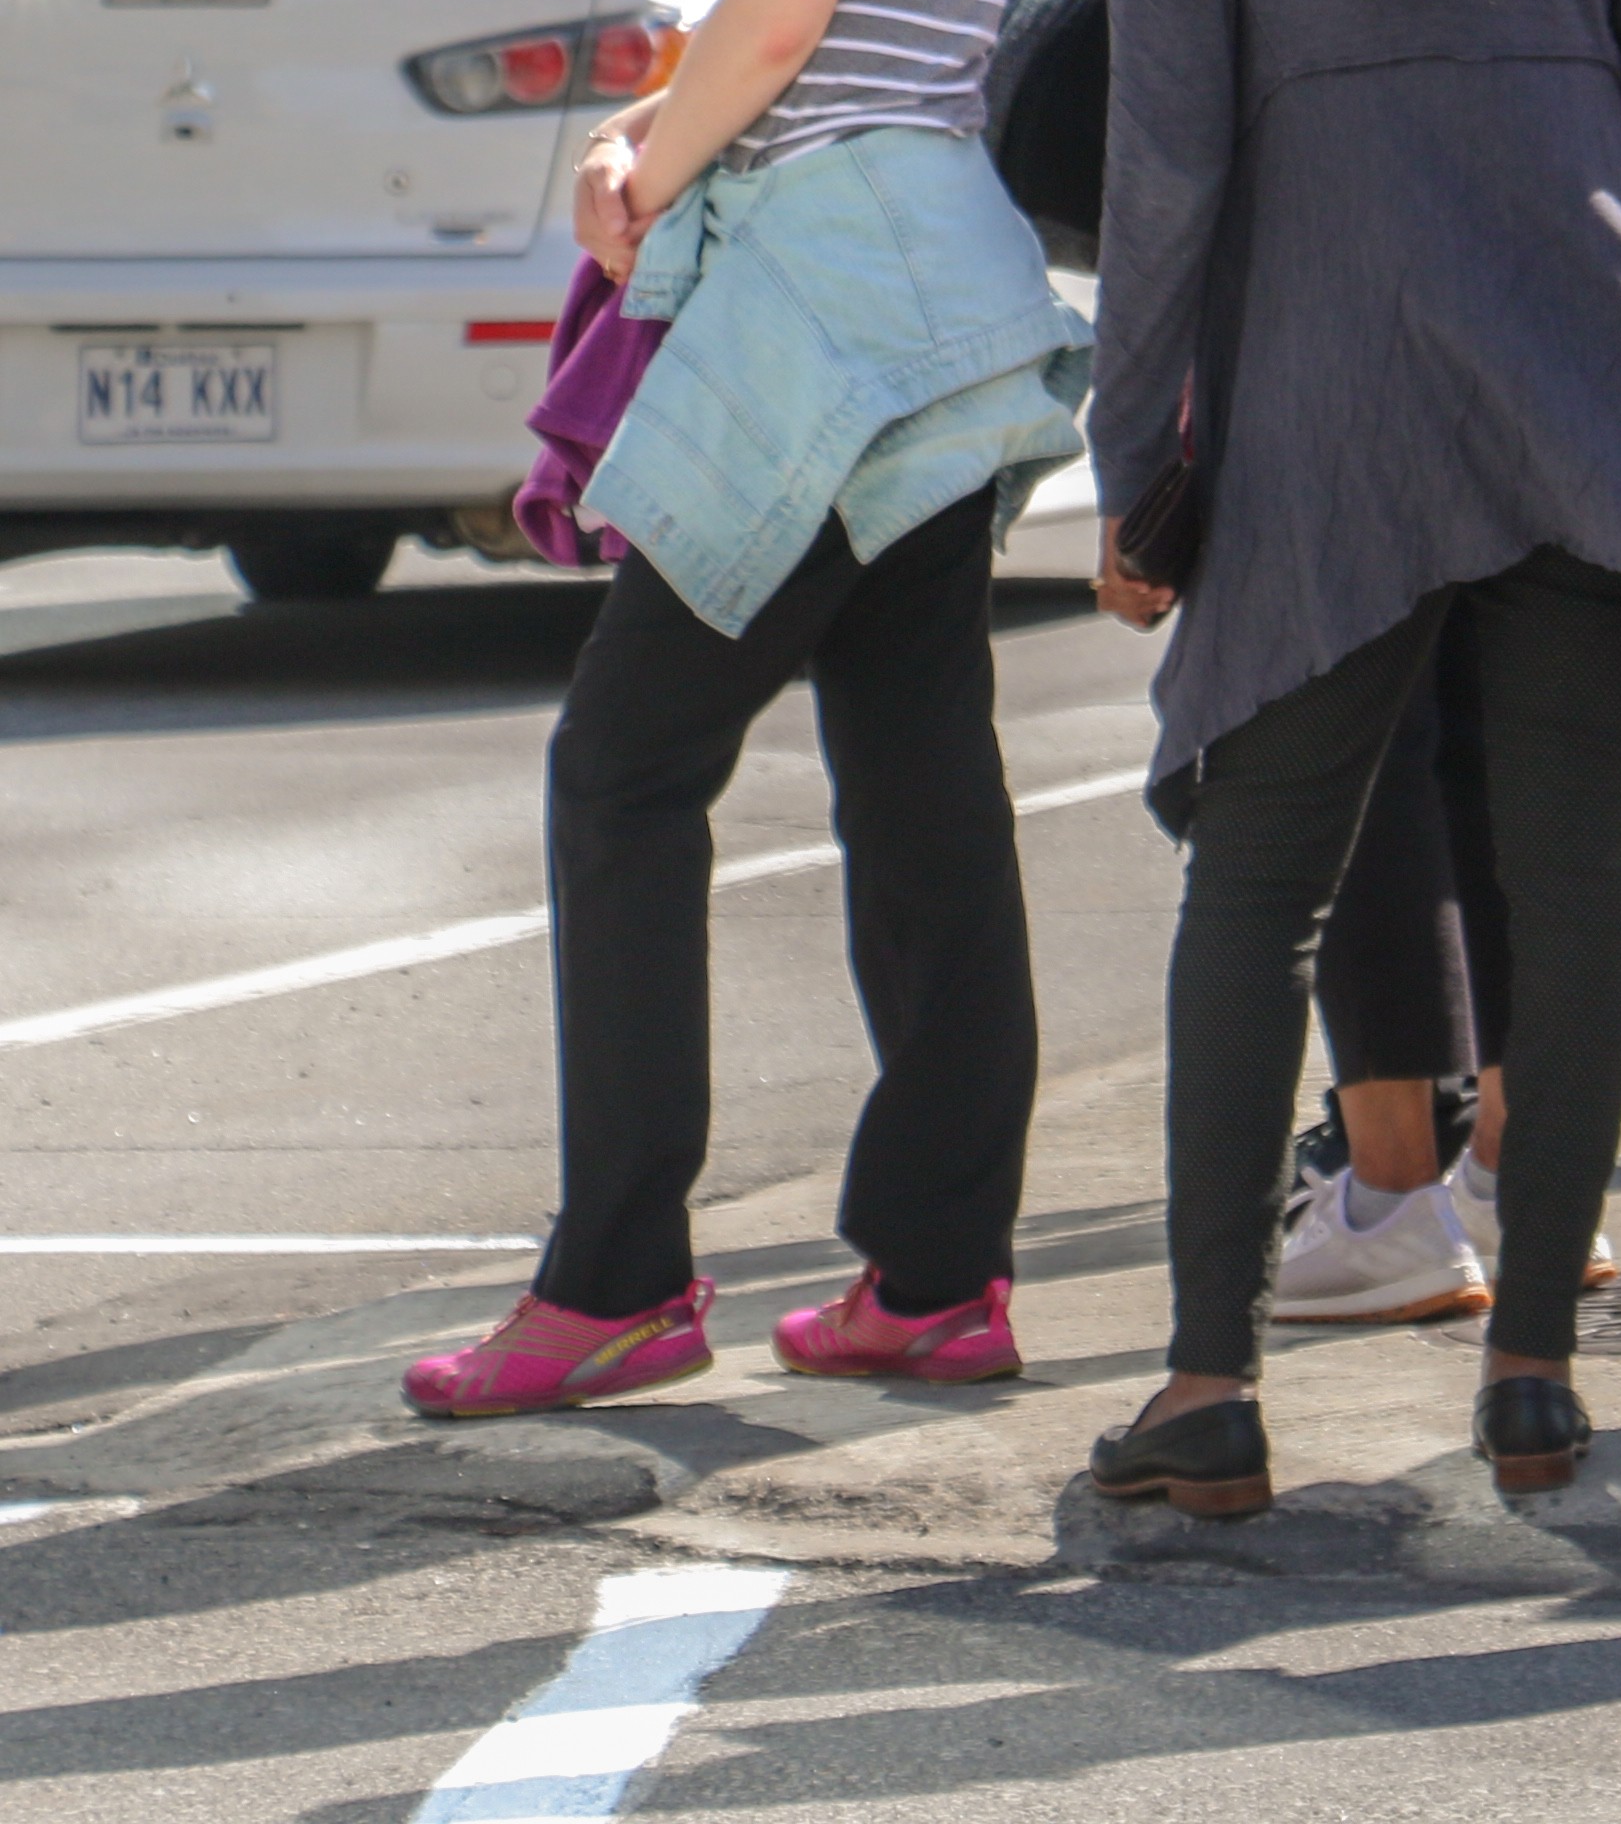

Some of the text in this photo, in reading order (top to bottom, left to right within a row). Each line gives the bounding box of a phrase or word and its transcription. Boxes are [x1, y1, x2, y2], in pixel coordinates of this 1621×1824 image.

[86, 366, 267, 418] N14 KXX
[594, 1317, 674, 1366] MERRELL
